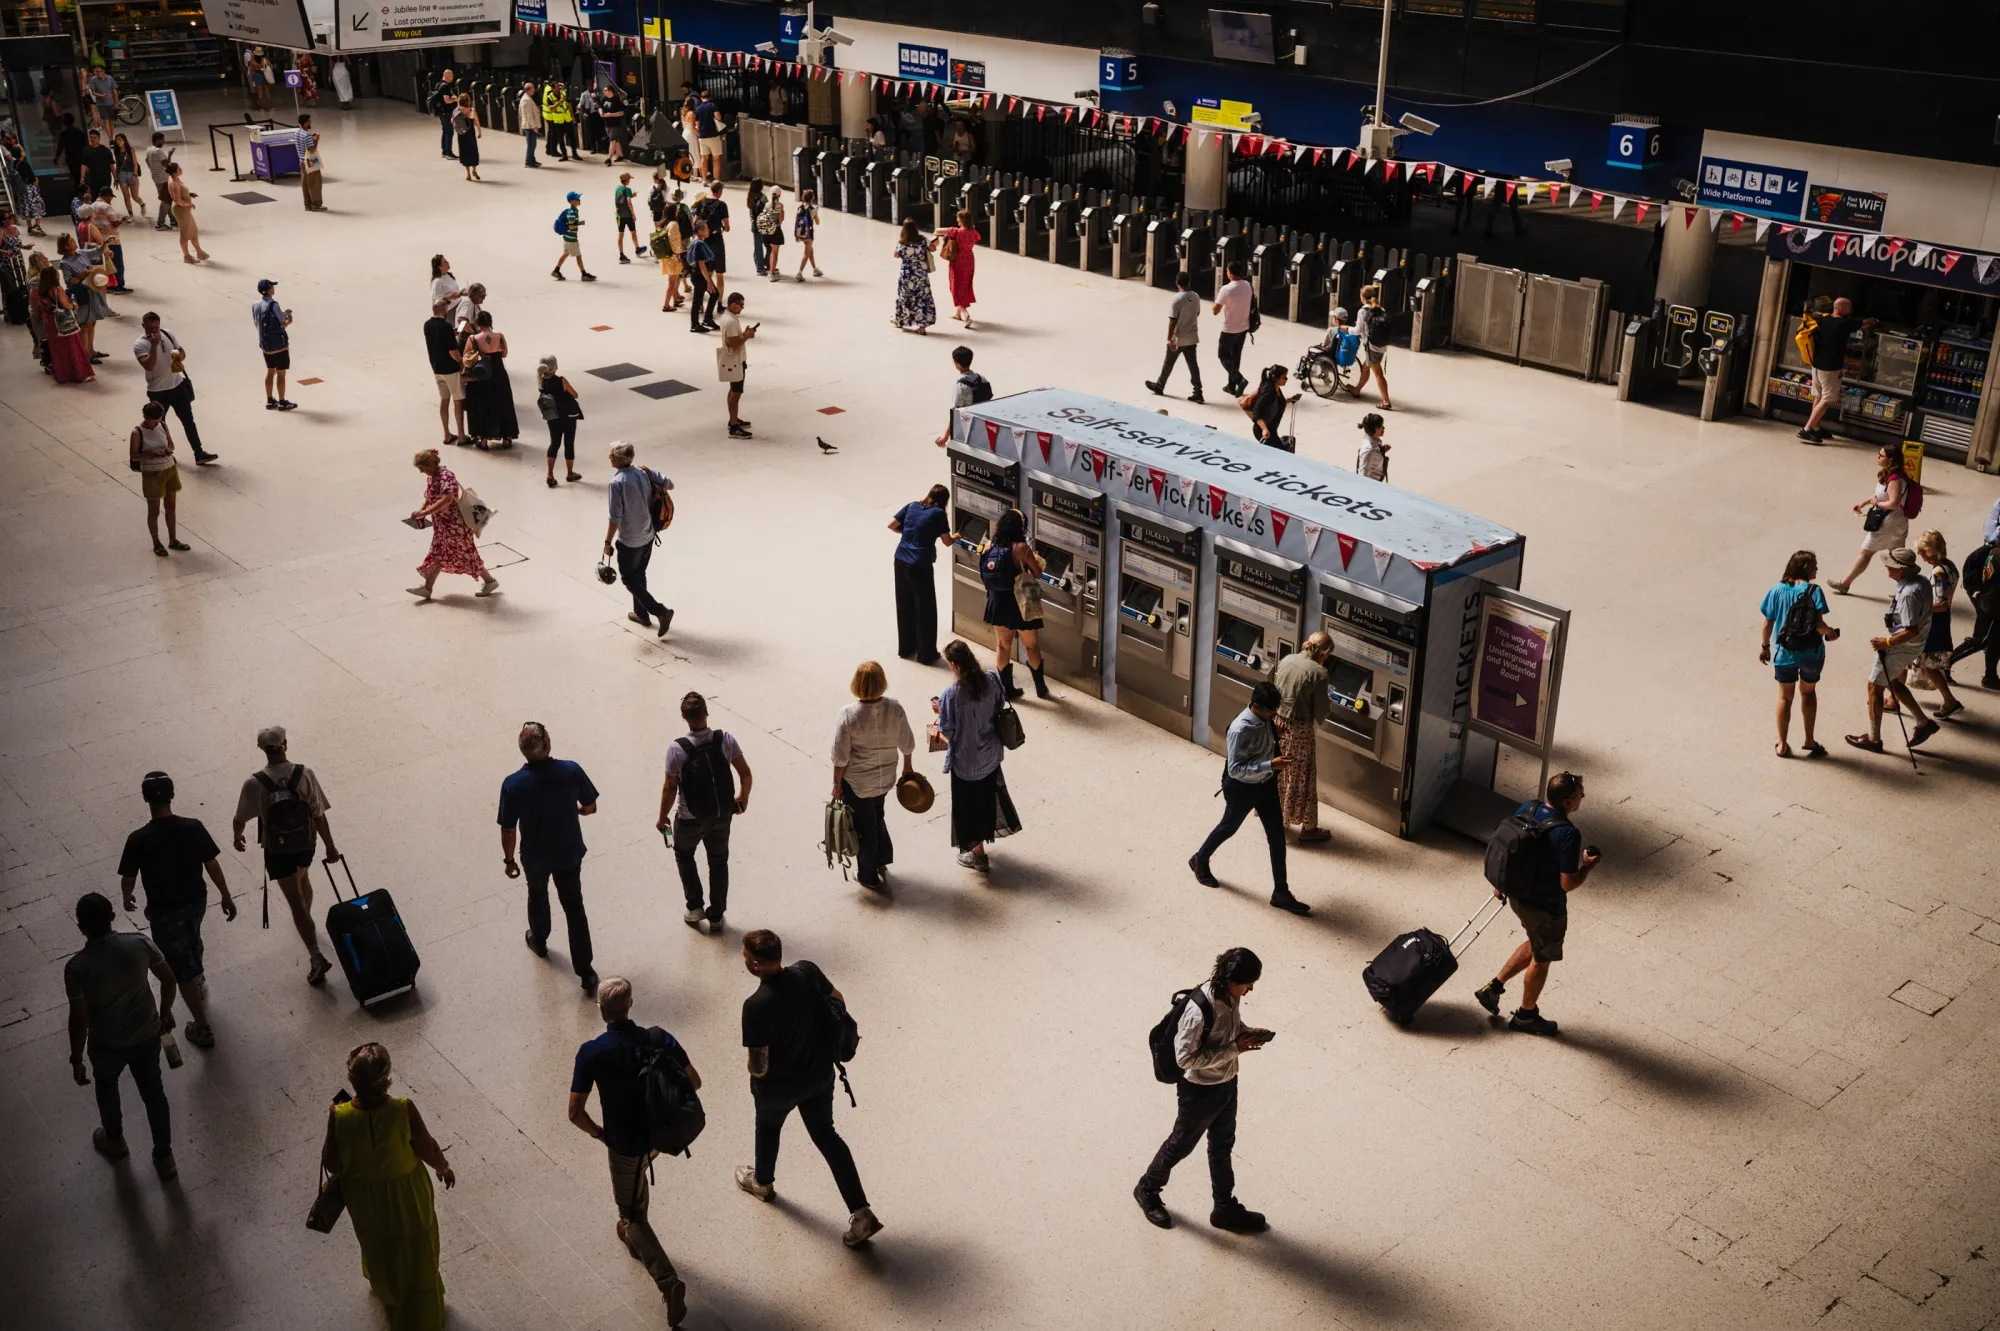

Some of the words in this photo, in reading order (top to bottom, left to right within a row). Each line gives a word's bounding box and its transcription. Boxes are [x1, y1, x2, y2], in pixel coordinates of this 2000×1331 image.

[394, 5, 417, 13] Jubilee
[410, 17, 439, 25] property
[784, 20, 792, 35] 4
[973, 66, 984, 74] WiFi
[1106, 63, 1115, 80] 5
[1128, 63, 1137, 80] 5
[1619, 134, 1633, 156] 6
[1650, 135, 1659, 156] 6
[1703, 188, 1720, 198] Wide
[1722, 191, 1753, 202] Platform
[1755, 196, 1772, 205] Gate
[1859, 198, 1884, 212] WiFi
[968, 464, 990, 477] TICKETS
[1047, 407, 1251, 473] Self-service
[1253, 470, 1393, 522] tickets
[1081, 450, 1188, 508] Slf-eric
[1197, 493, 1264, 536] tikes
[1056, 495, 1078, 510] TICKETS
[1145, 529, 1170, 543] TICKETS
[1246, 565, 1272, 580] TICKETS
[1243, 574, 1254, 583] Cash
[1264, 582, 1274, 590] Card
[1275, 586, 1297, 599] Payments
[1354, 606, 1383, 622] TICKETS
[1352, 615, 1363, 624] Card
[1364, 620, 1388, 633] Payments
[1495, 626, 1510, 638] This
[1511, 634, 1525, 646] way
[1527, 639, 1538, 650] for
[1452, 592, 1480, 718] TICKETS
[1501, 639, 1528, 655] London
[1489, 644, 1537, 669] Underground
[1487, 655, 1501, 665] and
[1503, 659, 1536, 678] Waterloo
[1500, 668, 1520, 681] Road
